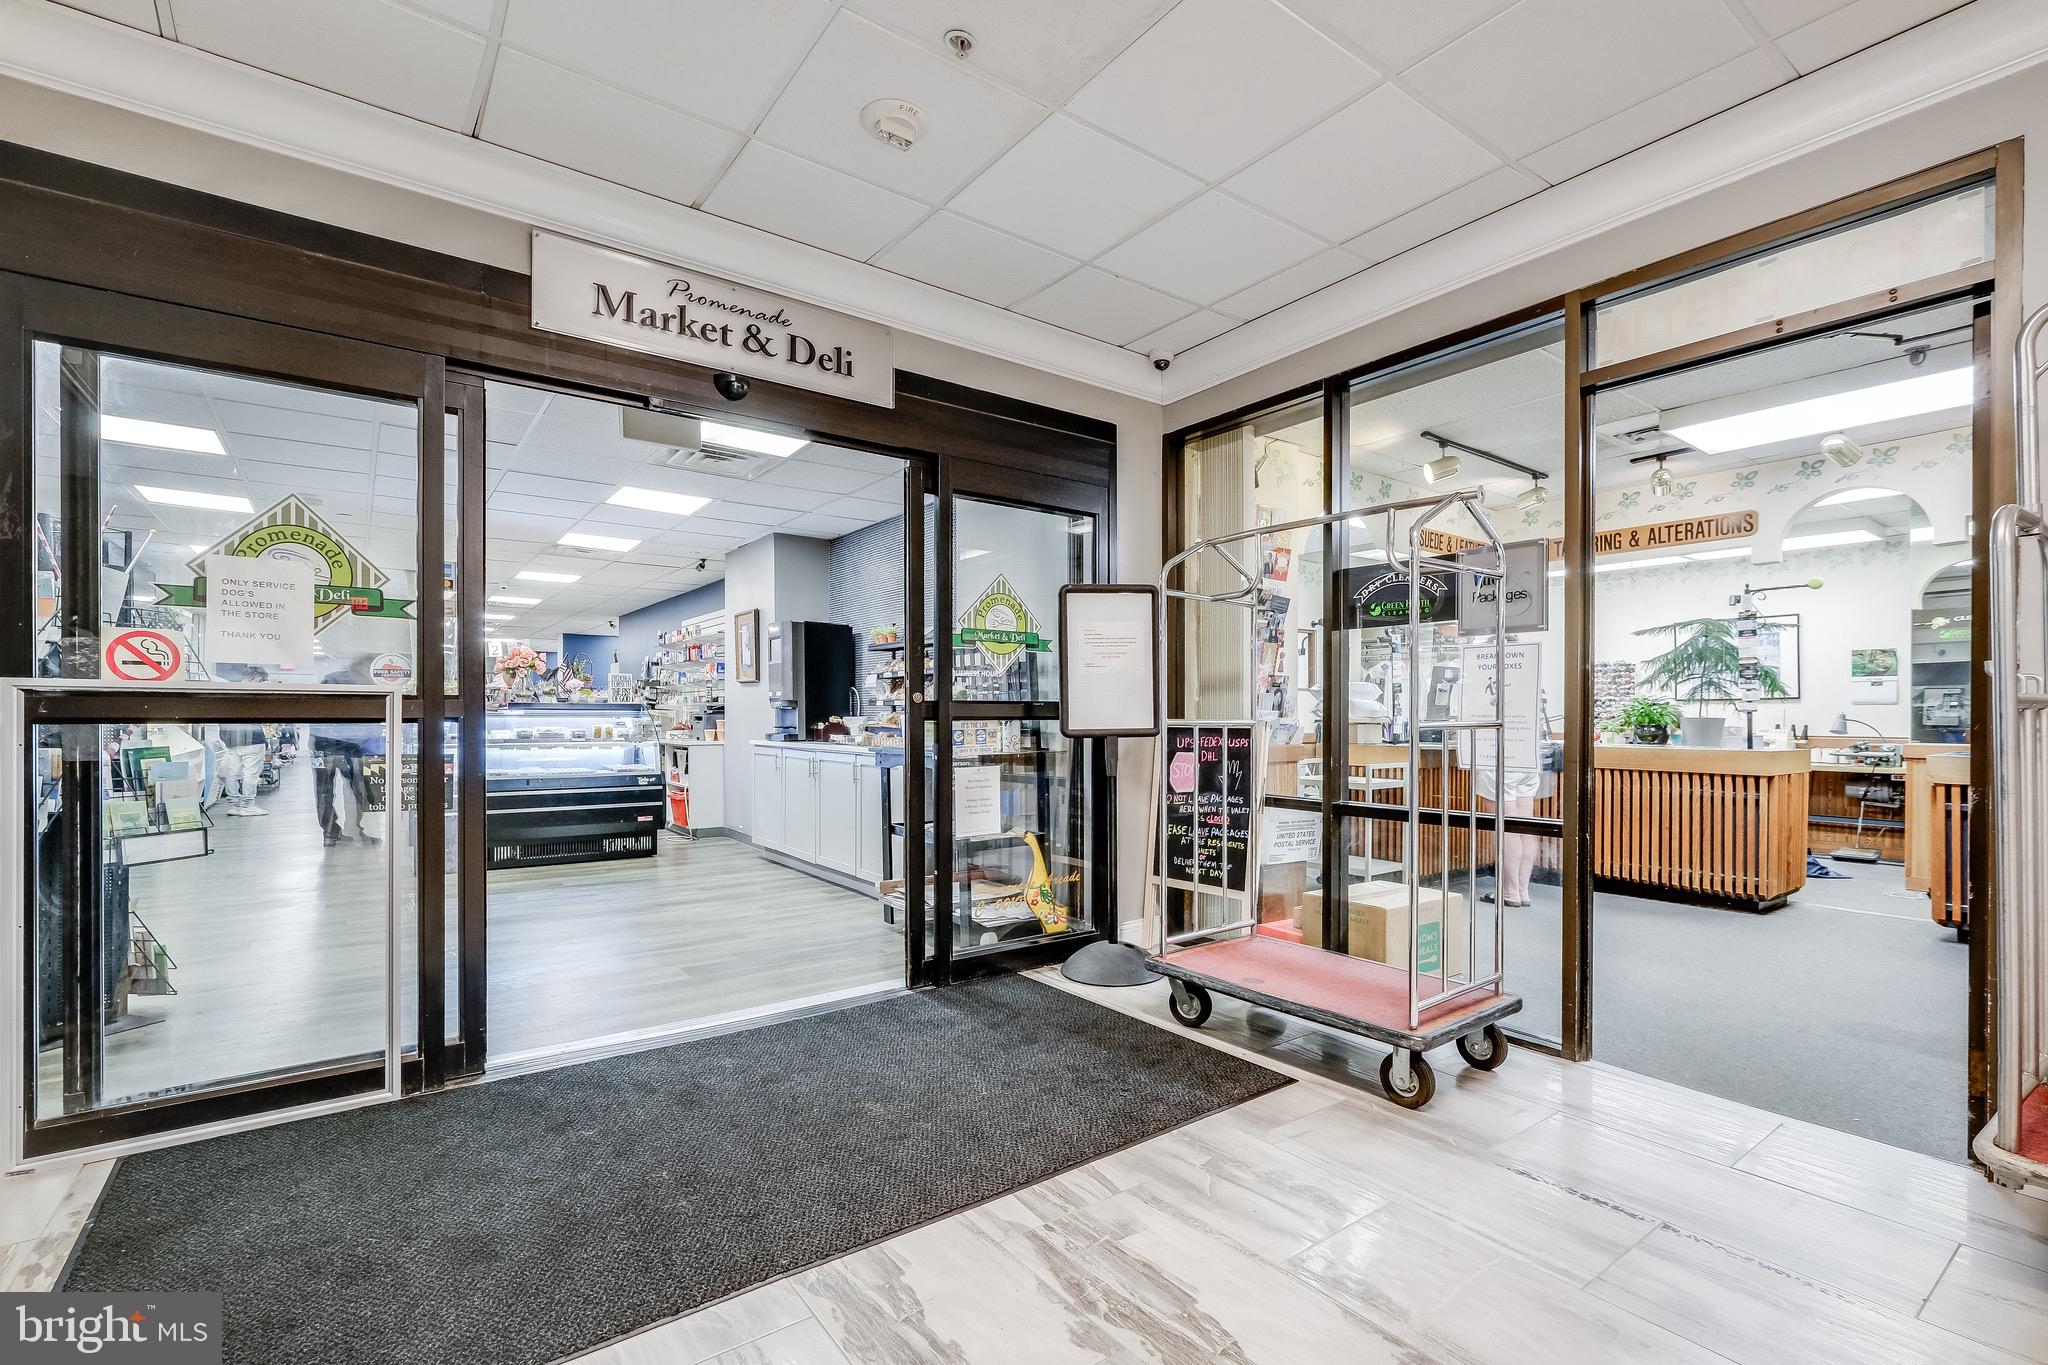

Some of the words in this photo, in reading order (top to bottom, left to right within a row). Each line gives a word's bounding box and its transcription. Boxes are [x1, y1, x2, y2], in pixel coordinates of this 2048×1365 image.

[899, 104, 920, 118] FIRE
[667, 278, 793, 328] Promenade
[591, 281, 734, 348] Market
[741, 323, 778, 357] &
[786, 332, 855, 378] Deli
[1628, 530, 1640, 547] &
[1647, 513, 1754, 546] ALTERATIONS
[1419, 529, 1444, 551] SUEDE
[1446, 536, 1452, 552] &
[1455, 539, 1487, 551] LEAT
[221, 577, 250, 588] ONLY
[252, 580, 296, 591] SERVICE
[1361, 579, 1381, 598] DRY
[1386, 573, 1439, 591] CLEAERS
[221, 588, 255, 598] DOG'S
[318, 588, 352, 602] Deli
[220, 599, 273, 609] ALLOWED
[275, 602, 286, 610] IN
[977, 596, 1023, 621] Promenade
[220, 609, 242, 618] THE
[244, 611, 279, 620] STORE
[1381, 608, 1430, 616] CLEANG
[220, 630, 257, 640] THANK
[259, 631, 281, 641] YOU
[974, 630, 1001, 641] Market
[1001, 631, 1009, 641] &
[1010, 632, 1026, 643] Deli
[1504, 662, 1523, 670] OXES
[1177, 737, 1194, 749] UPS
[1200, 736, 1223, 748] FEDEX
[1228, 738, 1250, 748] USPS
[1201, 750, 1218, 762] DHL
[369, 776, 385, 785] No
[404, 793, 416, 801] be
[1173, 794, 1188, 804] NOT
[1188, 795, 1210, 804] LAVE
[1210, 793, 1244, 804] PACAGES
[1188, 826, 1210, 836] LAVE
[1276, 831, 1296, 840] UNITED
[1296, 830, 1316, 839] STATES
[1207, 838, 1245, 850] RESENTS
[1273, 840, 1295, 848] POSTAL
[1295, 838, 1317, 847] SERVICE
[1209, 869, 1224, 879] DAY
